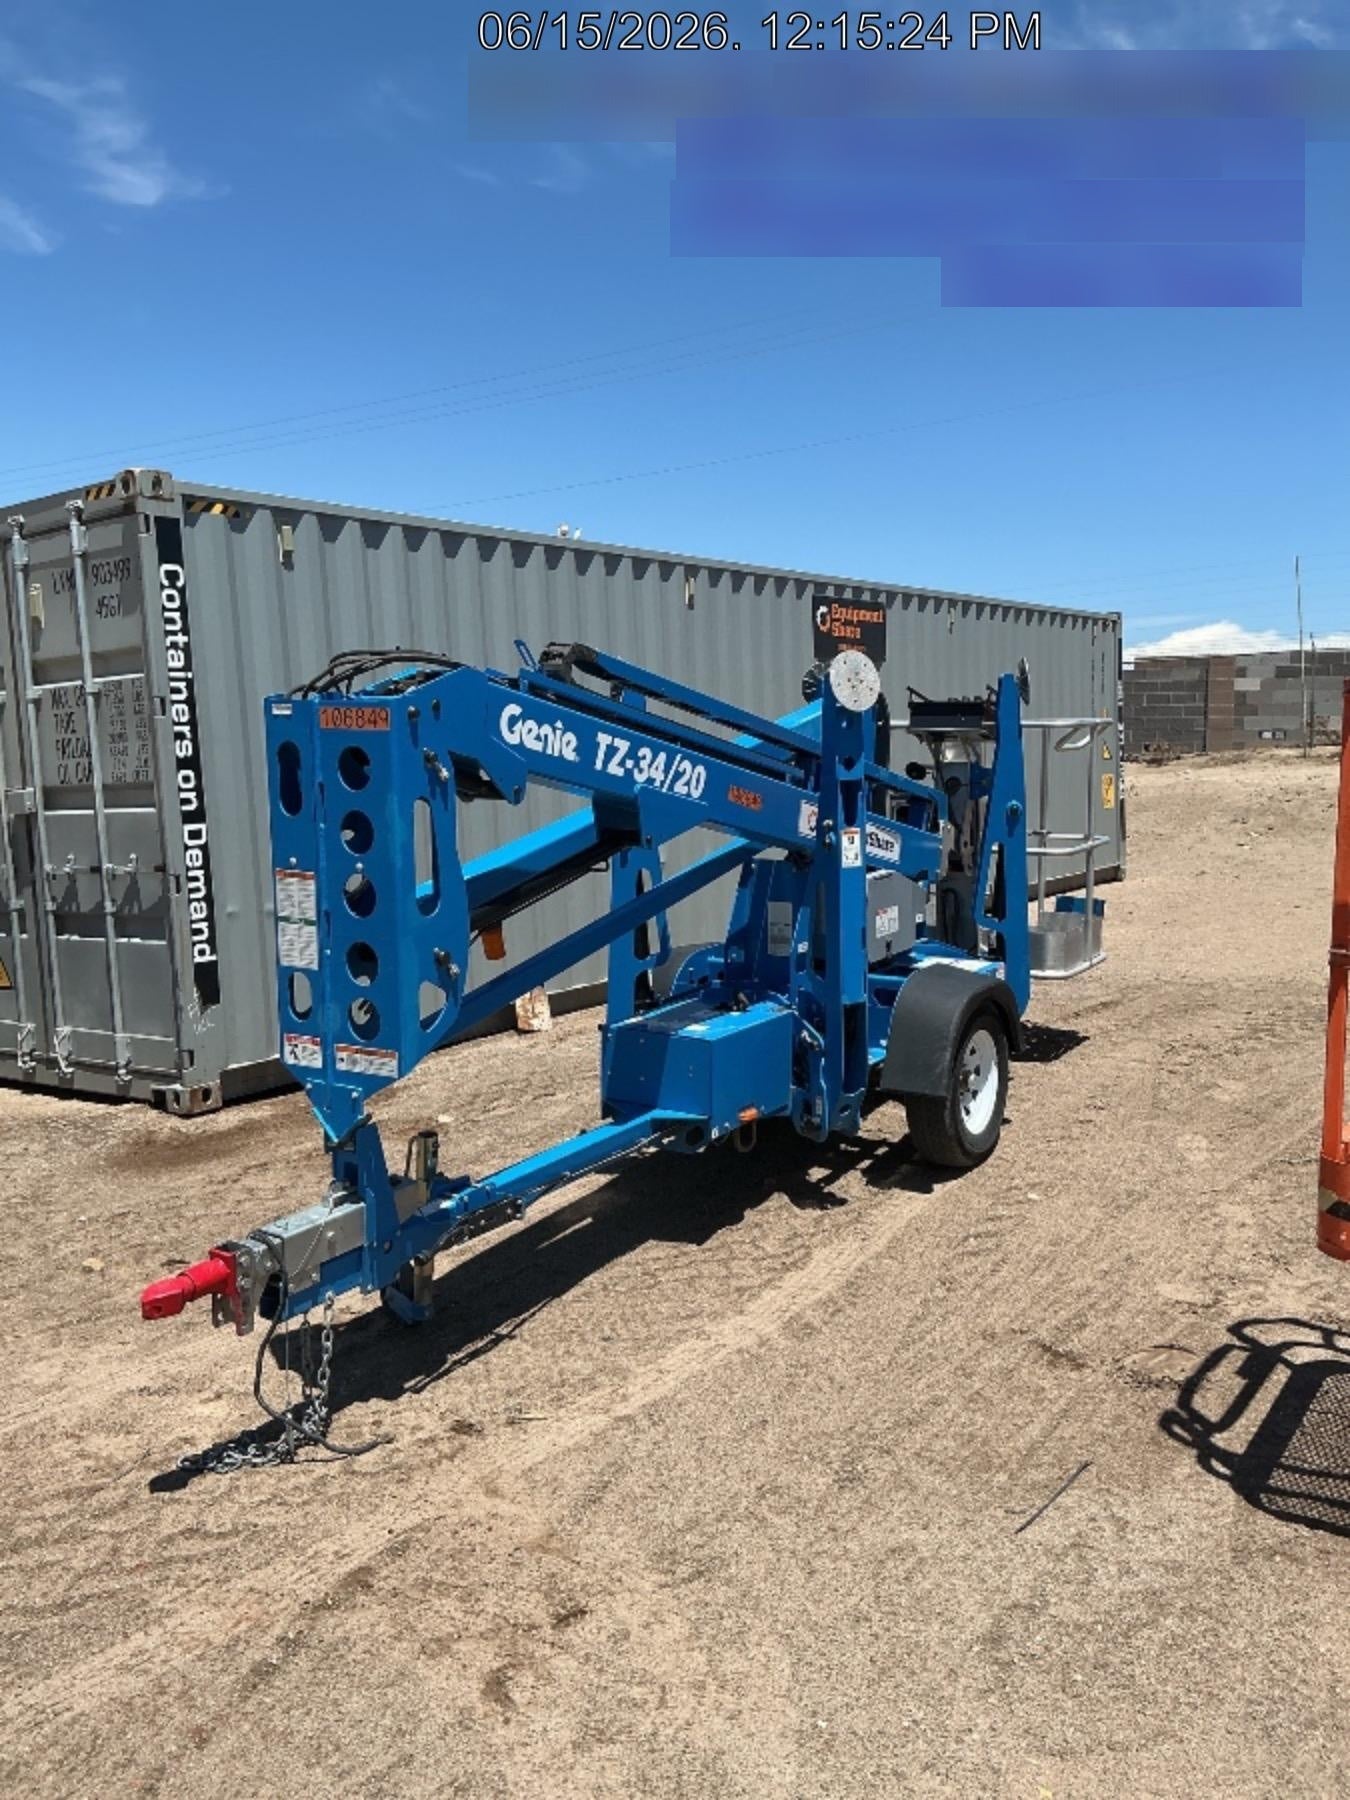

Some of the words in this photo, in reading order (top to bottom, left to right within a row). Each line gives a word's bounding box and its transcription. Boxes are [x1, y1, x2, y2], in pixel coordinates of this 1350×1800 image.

[159, 563, 193, 759] Containers
[321, 707, 389, 729] 106849
[500, 703, 579, 762] Genie
[594, 731, 707, 798] TZ-34/20
[177, 769, 199, 812] on
[183, 823, 217, 963] Demand
